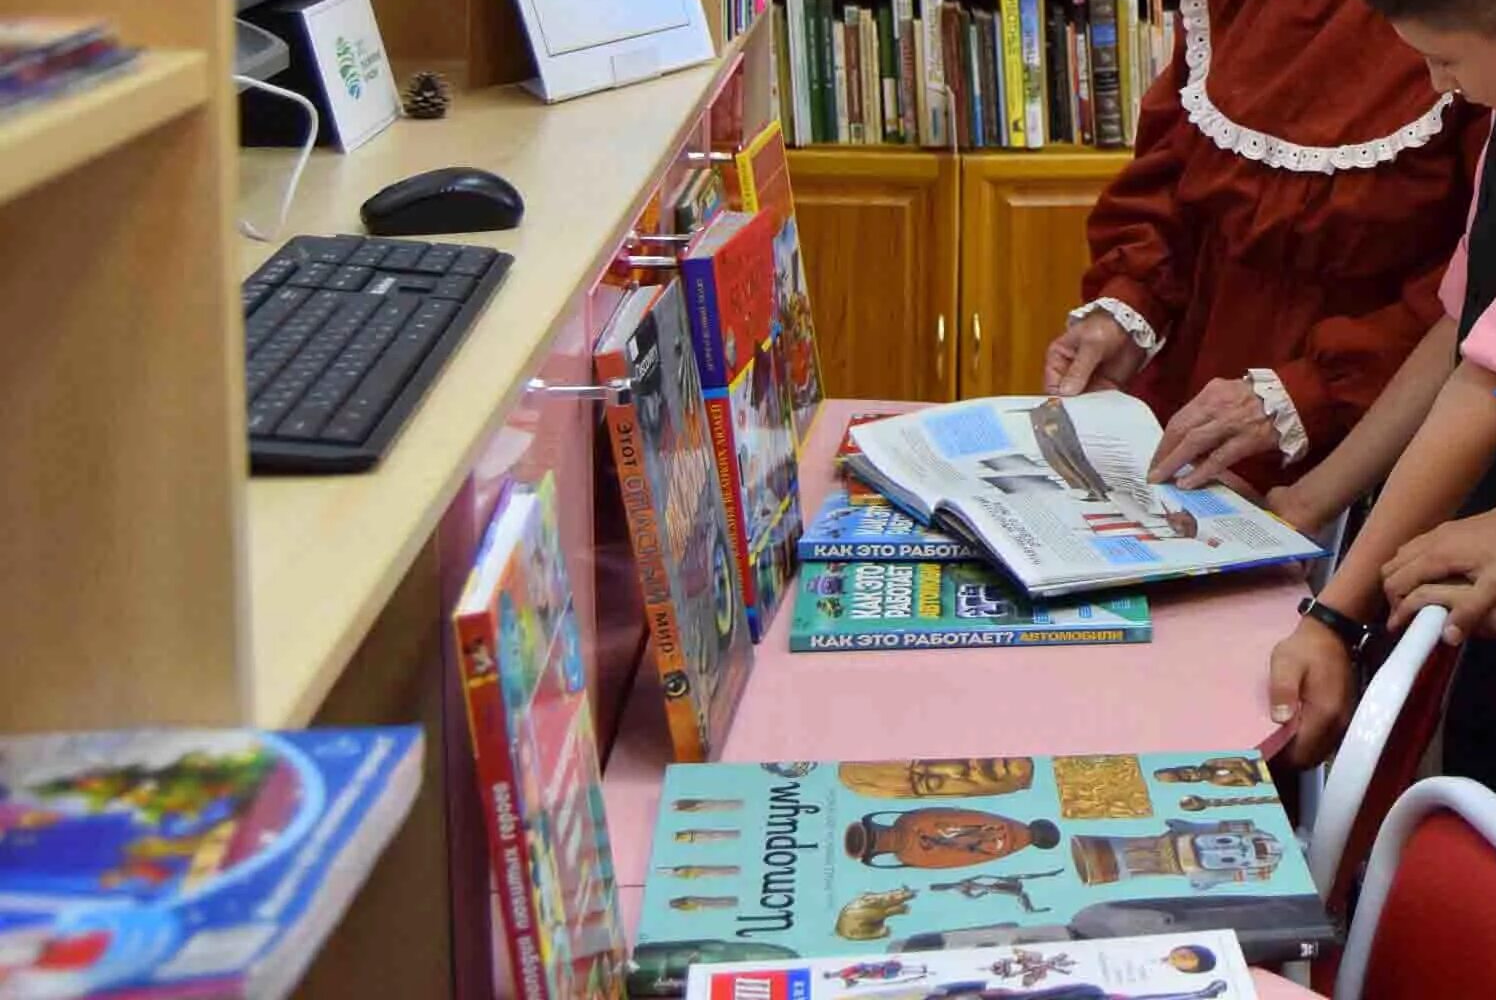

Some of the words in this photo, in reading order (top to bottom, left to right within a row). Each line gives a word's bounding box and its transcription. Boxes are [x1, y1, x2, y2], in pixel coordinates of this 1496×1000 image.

[814, 545, 852, 557] КАК
[858, 545, 896, 557] ЭТО
[899, 544, 977, 557] РАБОТА
[850, 590, 882, 619] КАК
[810, 634, 854, 649] КАК
[857, 634, 898, 647] ЭТО
[904, 631, 1014, 646] РАБОТАЕТ?
[734, 781, 820, 938] Историум
